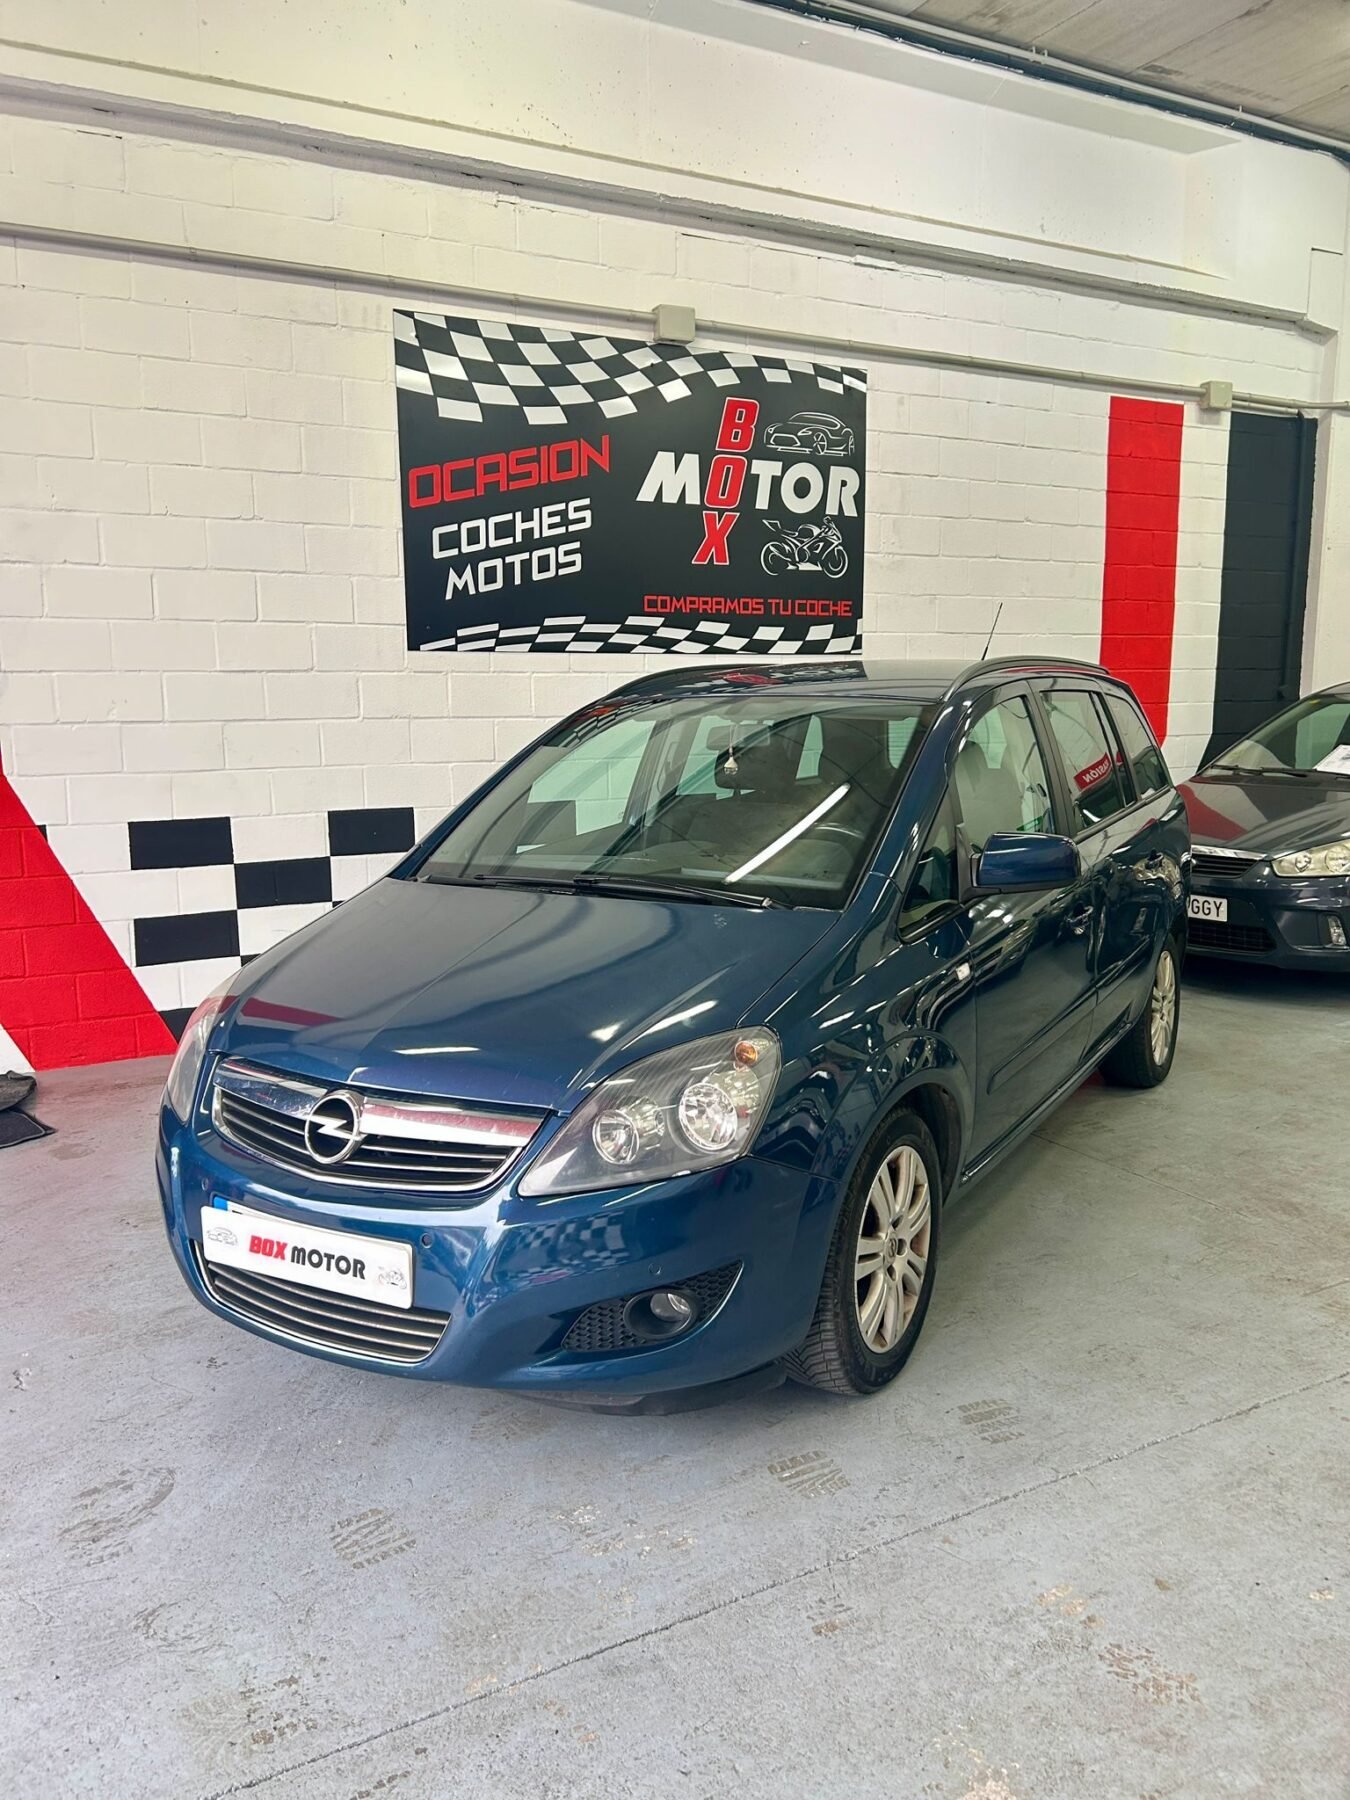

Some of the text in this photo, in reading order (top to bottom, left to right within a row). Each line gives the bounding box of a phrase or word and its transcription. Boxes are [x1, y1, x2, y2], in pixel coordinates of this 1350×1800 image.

[409, 435, 609, 508] OCASION
[636, 451, 860, 517] MOTOR
[692, 397, 759, 565] BOX
[432, 498, 592, 559] COCHES
[445, 541, 582, 600] MOTOS
[644, 595, 852, 616] COMPRAMOS TU COCHE
[1188, 898, 1222, 917] GGY
[249, 1235, 365, 1279] BOX MOTOR
